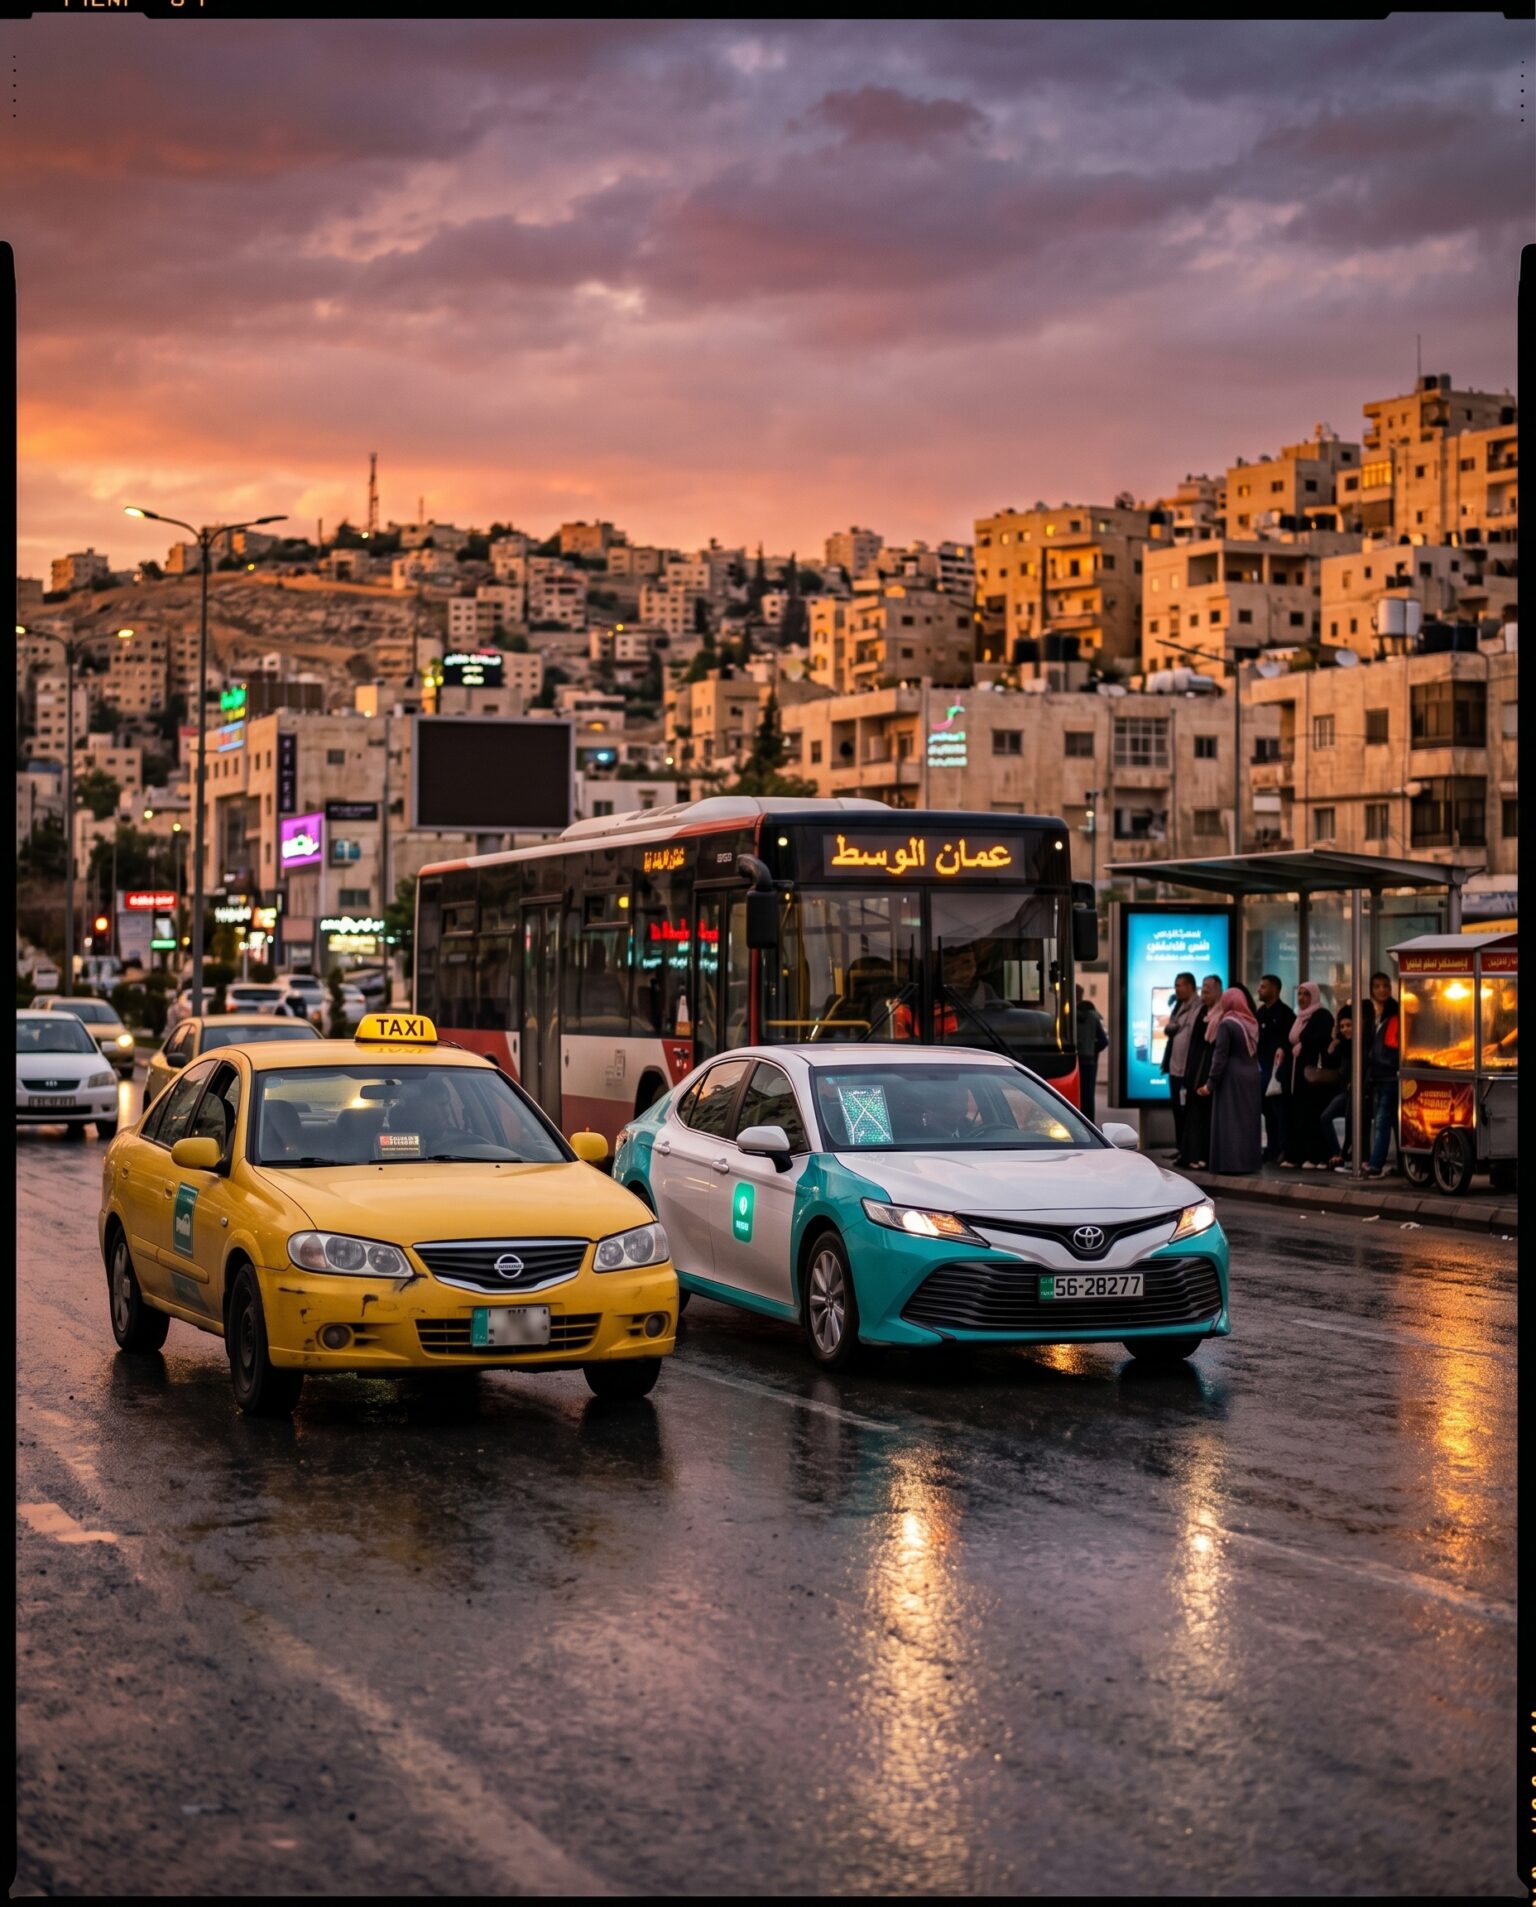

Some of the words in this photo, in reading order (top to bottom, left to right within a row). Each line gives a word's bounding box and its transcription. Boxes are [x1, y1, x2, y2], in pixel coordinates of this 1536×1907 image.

[831, 834, 925, 875] الوسط
[935, 838, 1012, 875] عمان
[376, 1019, 424, 1036] TAXI
[1055, 1276, 1141, 1297] 56-28277
